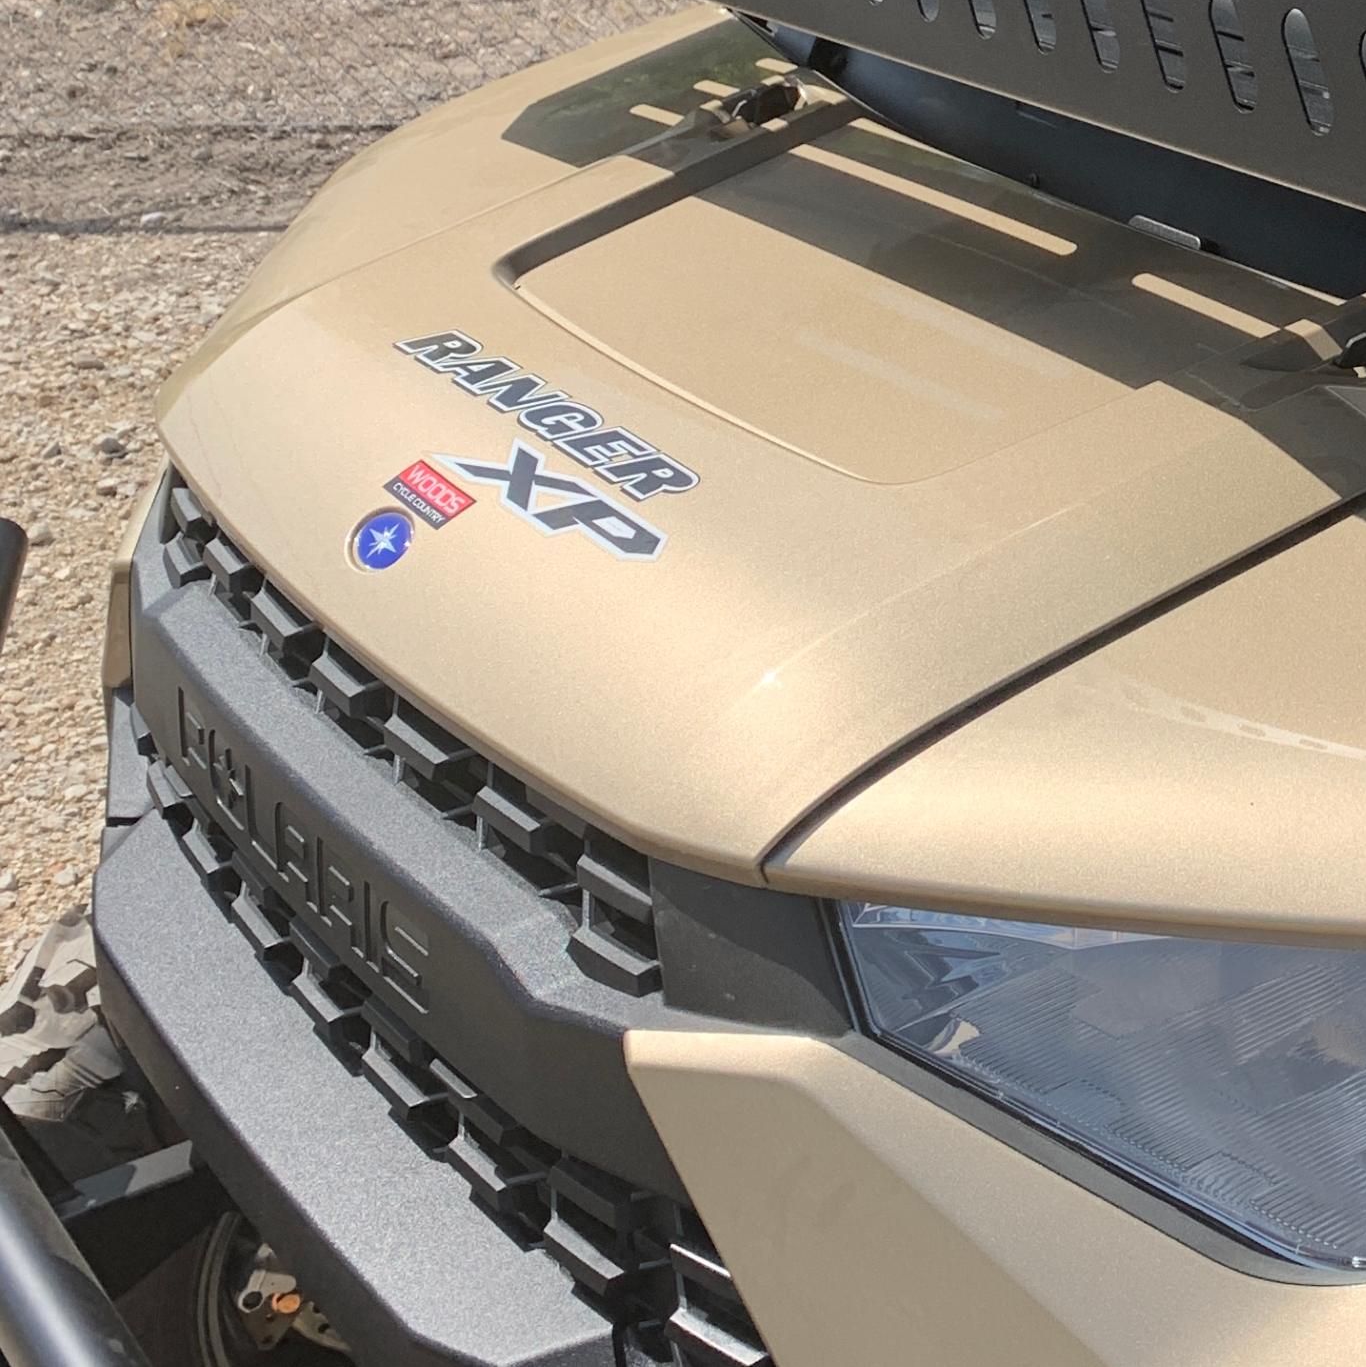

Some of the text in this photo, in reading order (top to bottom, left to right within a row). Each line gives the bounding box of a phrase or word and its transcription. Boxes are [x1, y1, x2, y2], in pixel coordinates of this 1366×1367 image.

[393, 329, 701, 502] RANGER
[392, 482, 446, 524] CYCLE COUNTRY
[406, 463, 467, 515] WOODS
[431, 436, 669, 561] XP
[177, 685, 431, 1015] POLARIS
